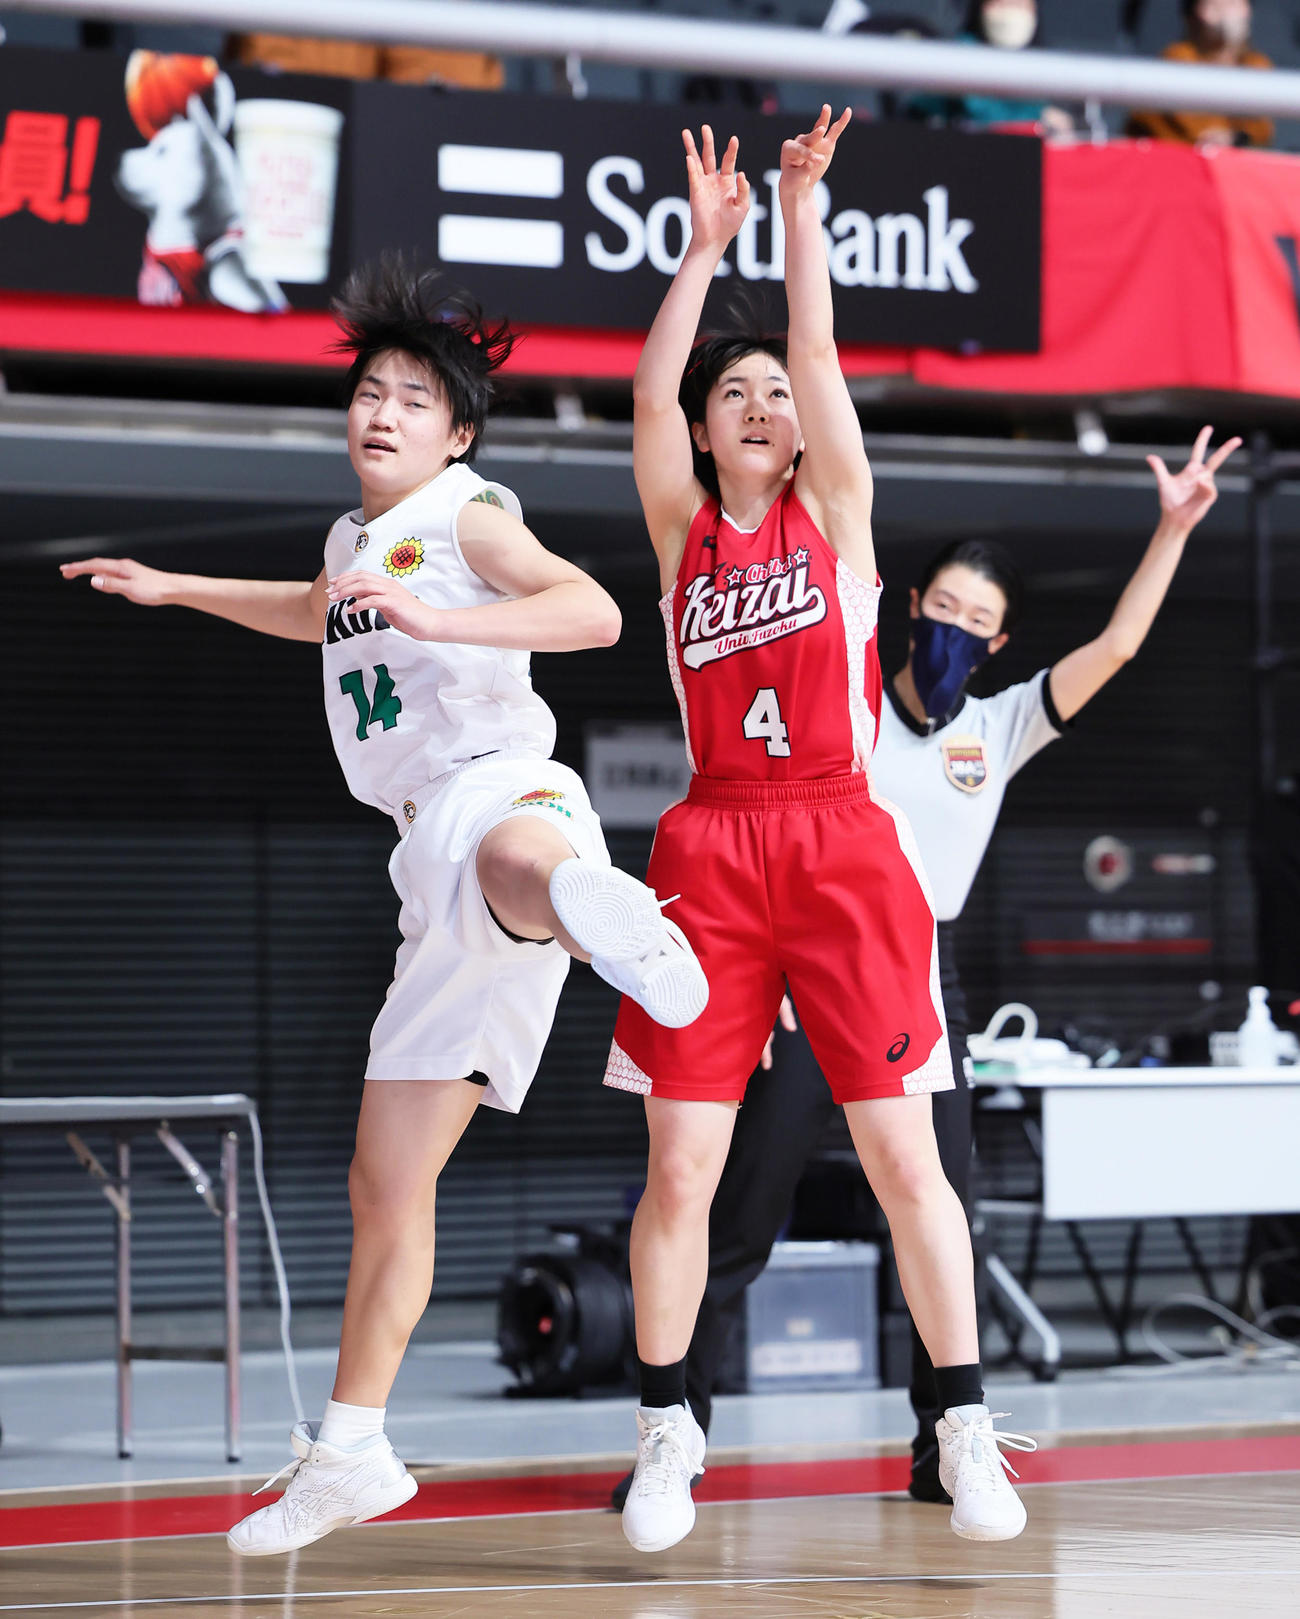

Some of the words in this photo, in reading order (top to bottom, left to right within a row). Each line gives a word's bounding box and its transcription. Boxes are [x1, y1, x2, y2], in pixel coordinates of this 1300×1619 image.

[585, 154, 979, 294] SotBank
[338, 662, 403, 742] 14
[742, 687, 791, 757] 4
